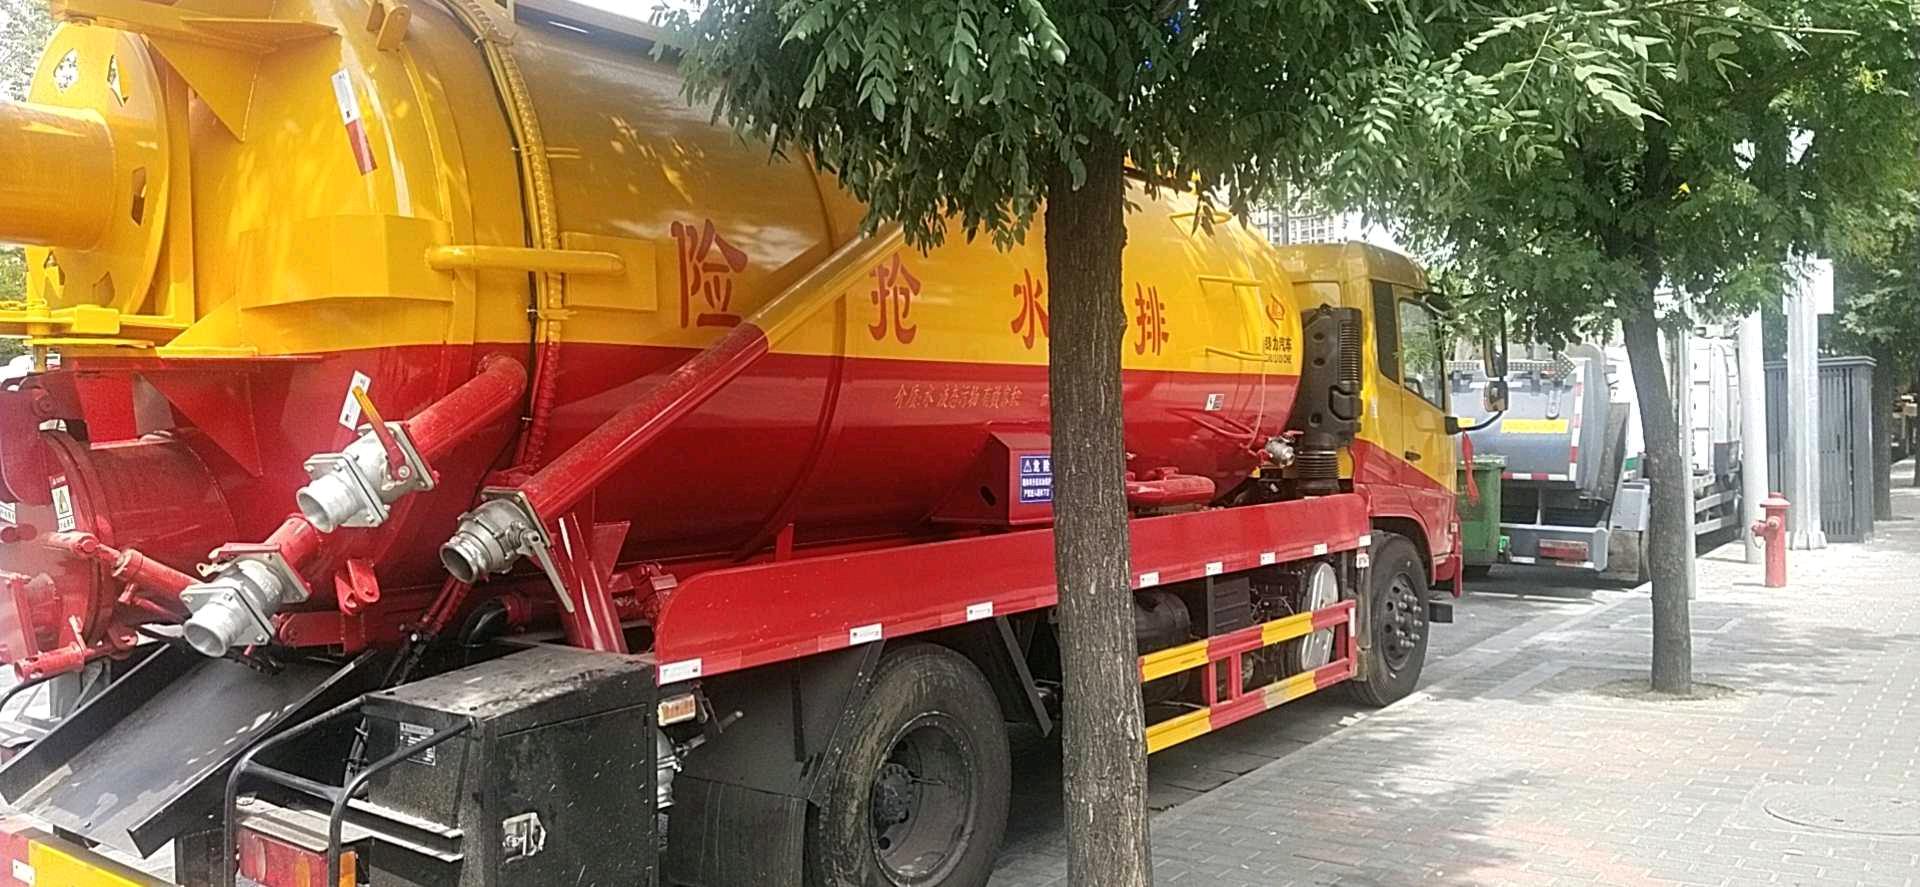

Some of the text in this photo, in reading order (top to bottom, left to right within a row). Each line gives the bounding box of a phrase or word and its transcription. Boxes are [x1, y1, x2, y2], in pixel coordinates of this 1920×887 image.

[671, 219, 1169, 356] 险 抢 水 排
